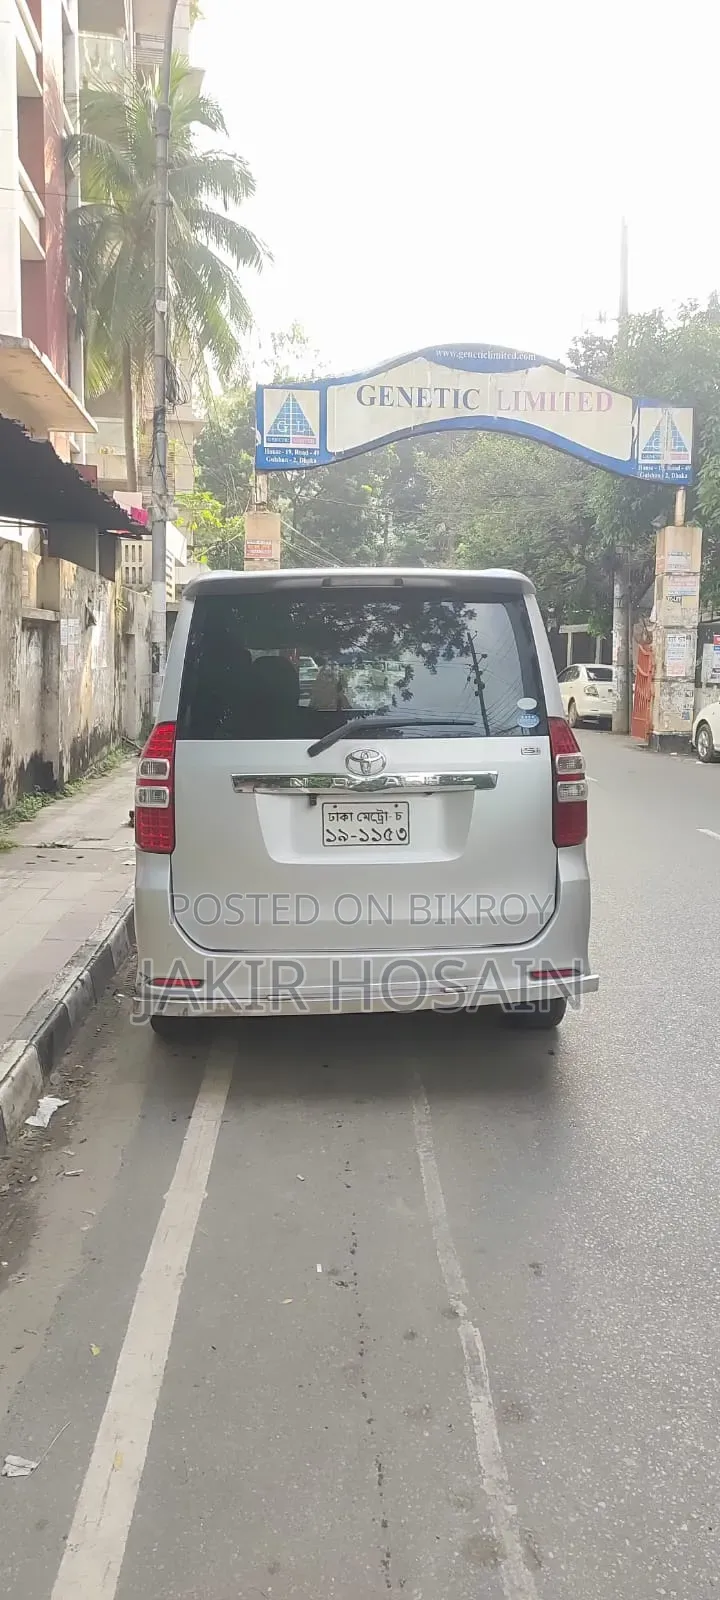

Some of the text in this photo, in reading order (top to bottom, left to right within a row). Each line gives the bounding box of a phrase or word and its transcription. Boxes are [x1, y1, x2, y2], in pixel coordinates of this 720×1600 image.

[436, 350, 536, 361] www.geneticlimited.com
[356, 384, 614, 413] GENETIC LIMITED
[327, 811, 354, 822] ঢাকা
[325, 827, 407, 842] ১৯-১১৫৩
